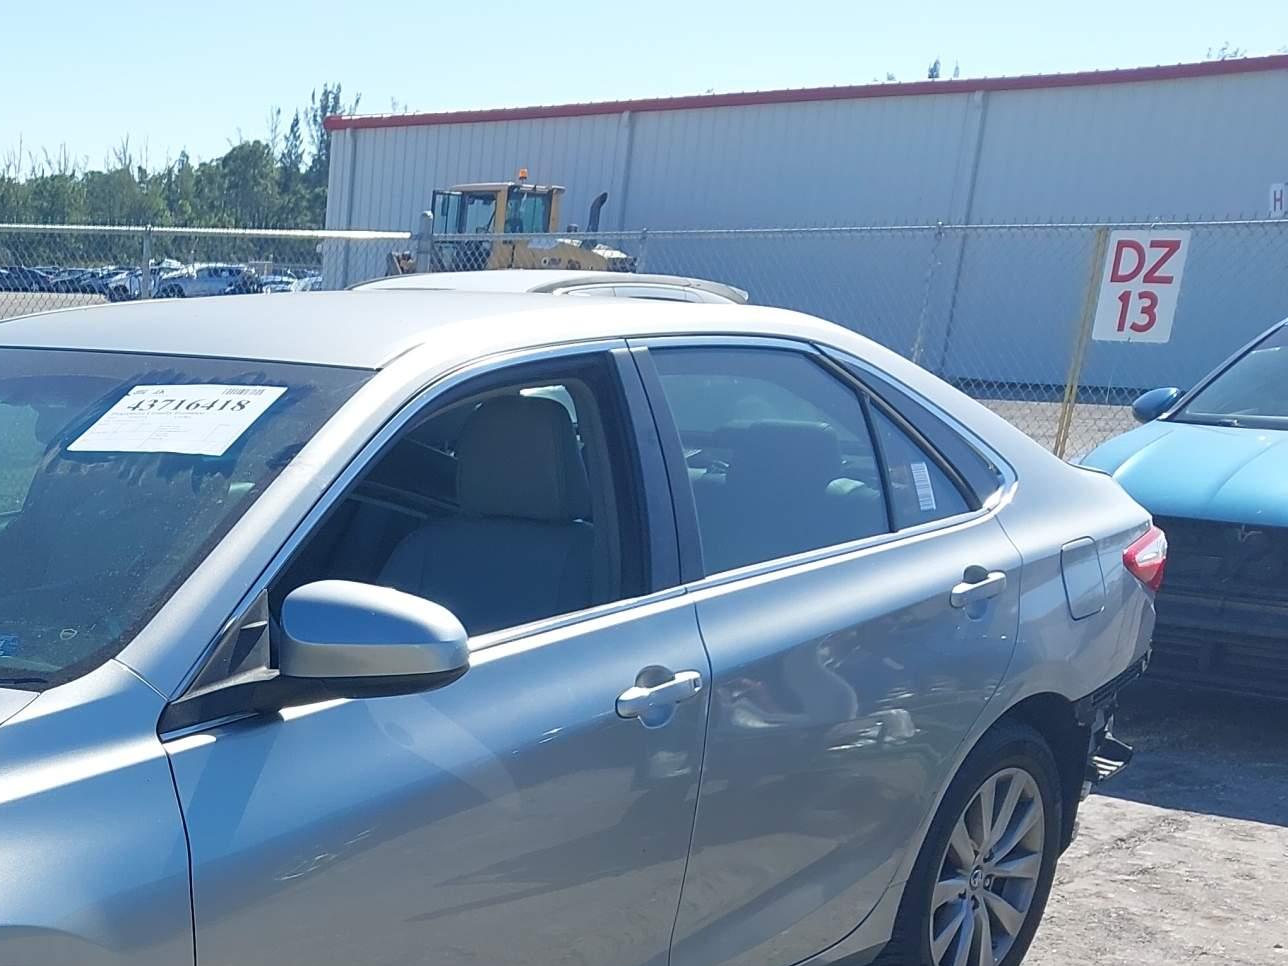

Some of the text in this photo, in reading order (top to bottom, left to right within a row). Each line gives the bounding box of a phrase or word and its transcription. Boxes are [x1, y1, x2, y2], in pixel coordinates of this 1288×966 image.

[1110, 239, 1182, 285] DZ
[1116, 290, 1159, 333] 13
[127, 399, 251, 412] 43716418
